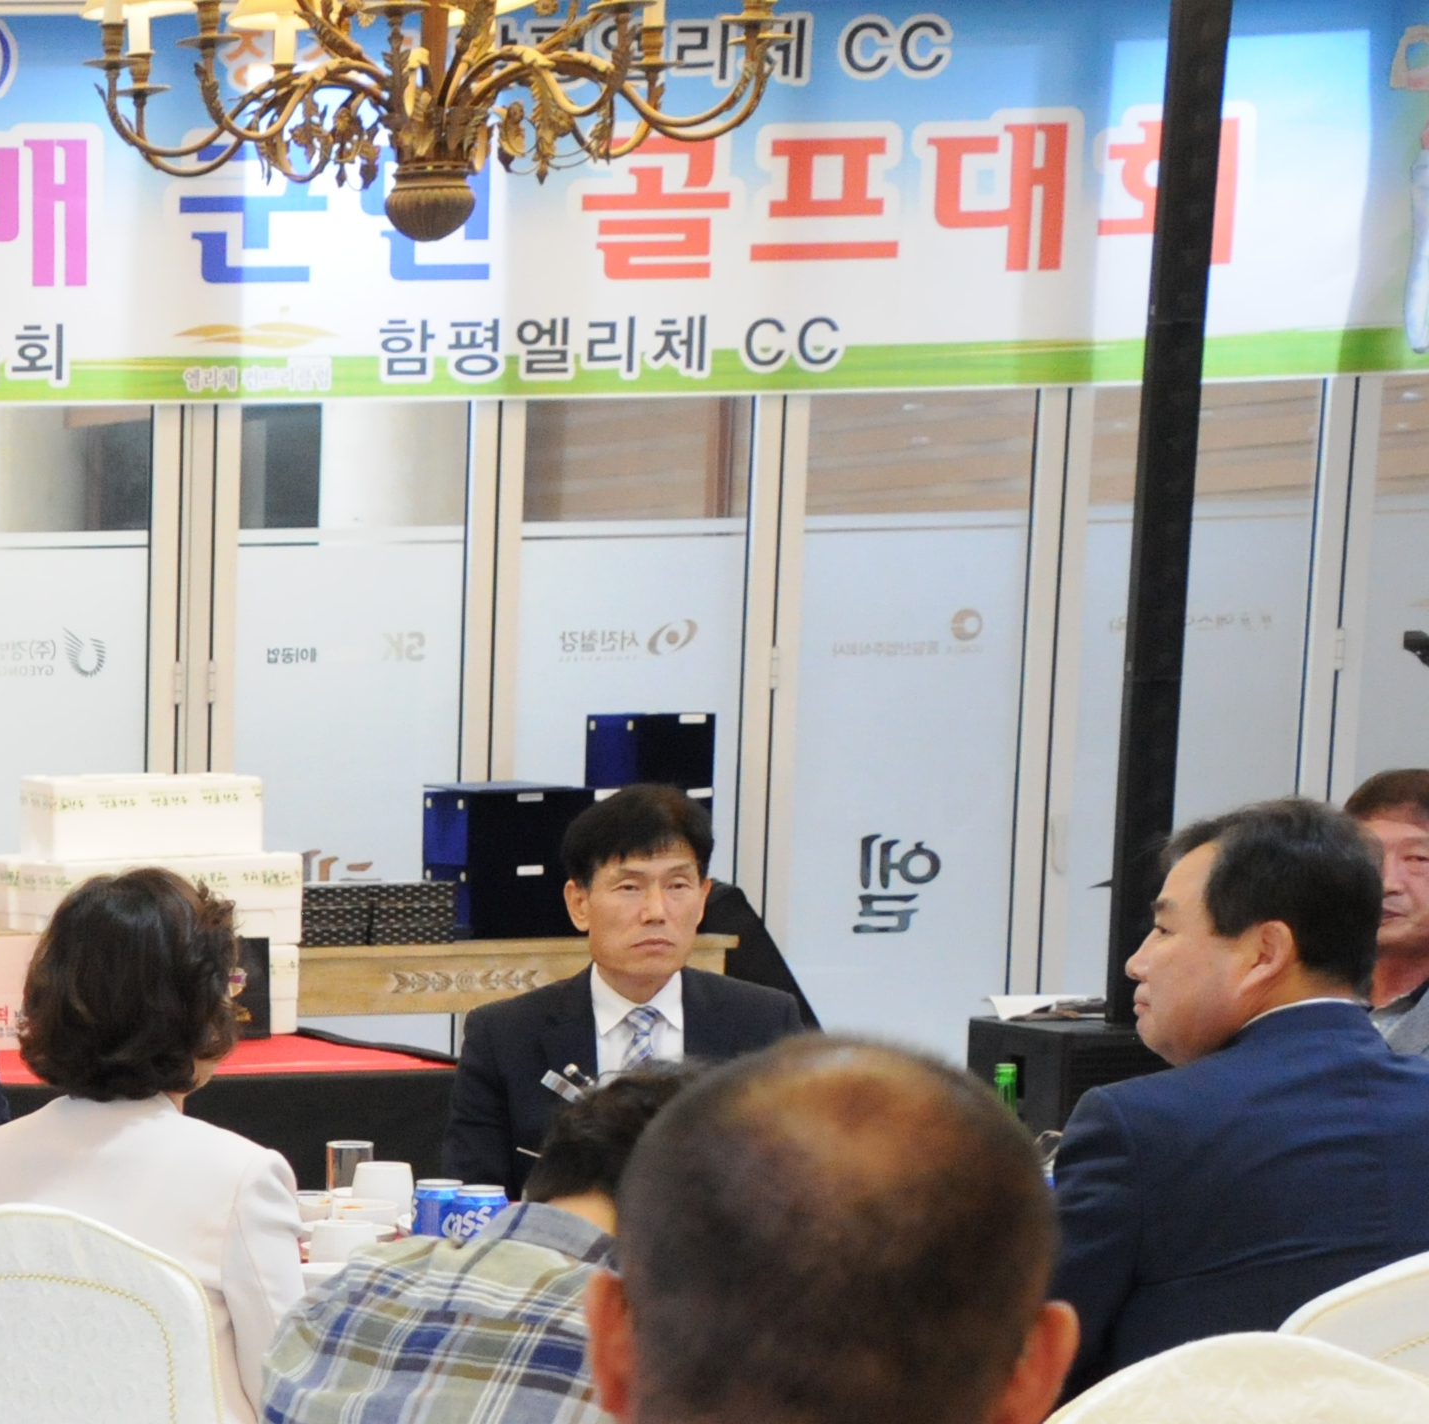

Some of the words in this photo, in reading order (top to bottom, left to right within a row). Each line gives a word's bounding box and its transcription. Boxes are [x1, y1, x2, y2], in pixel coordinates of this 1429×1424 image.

[844, 20, 945, 73] CC
[582, 117, 1240, 281] 골프대회
[378, 314, 708, 377] 함평엘리체
[744, 316, 839, 367] CC
